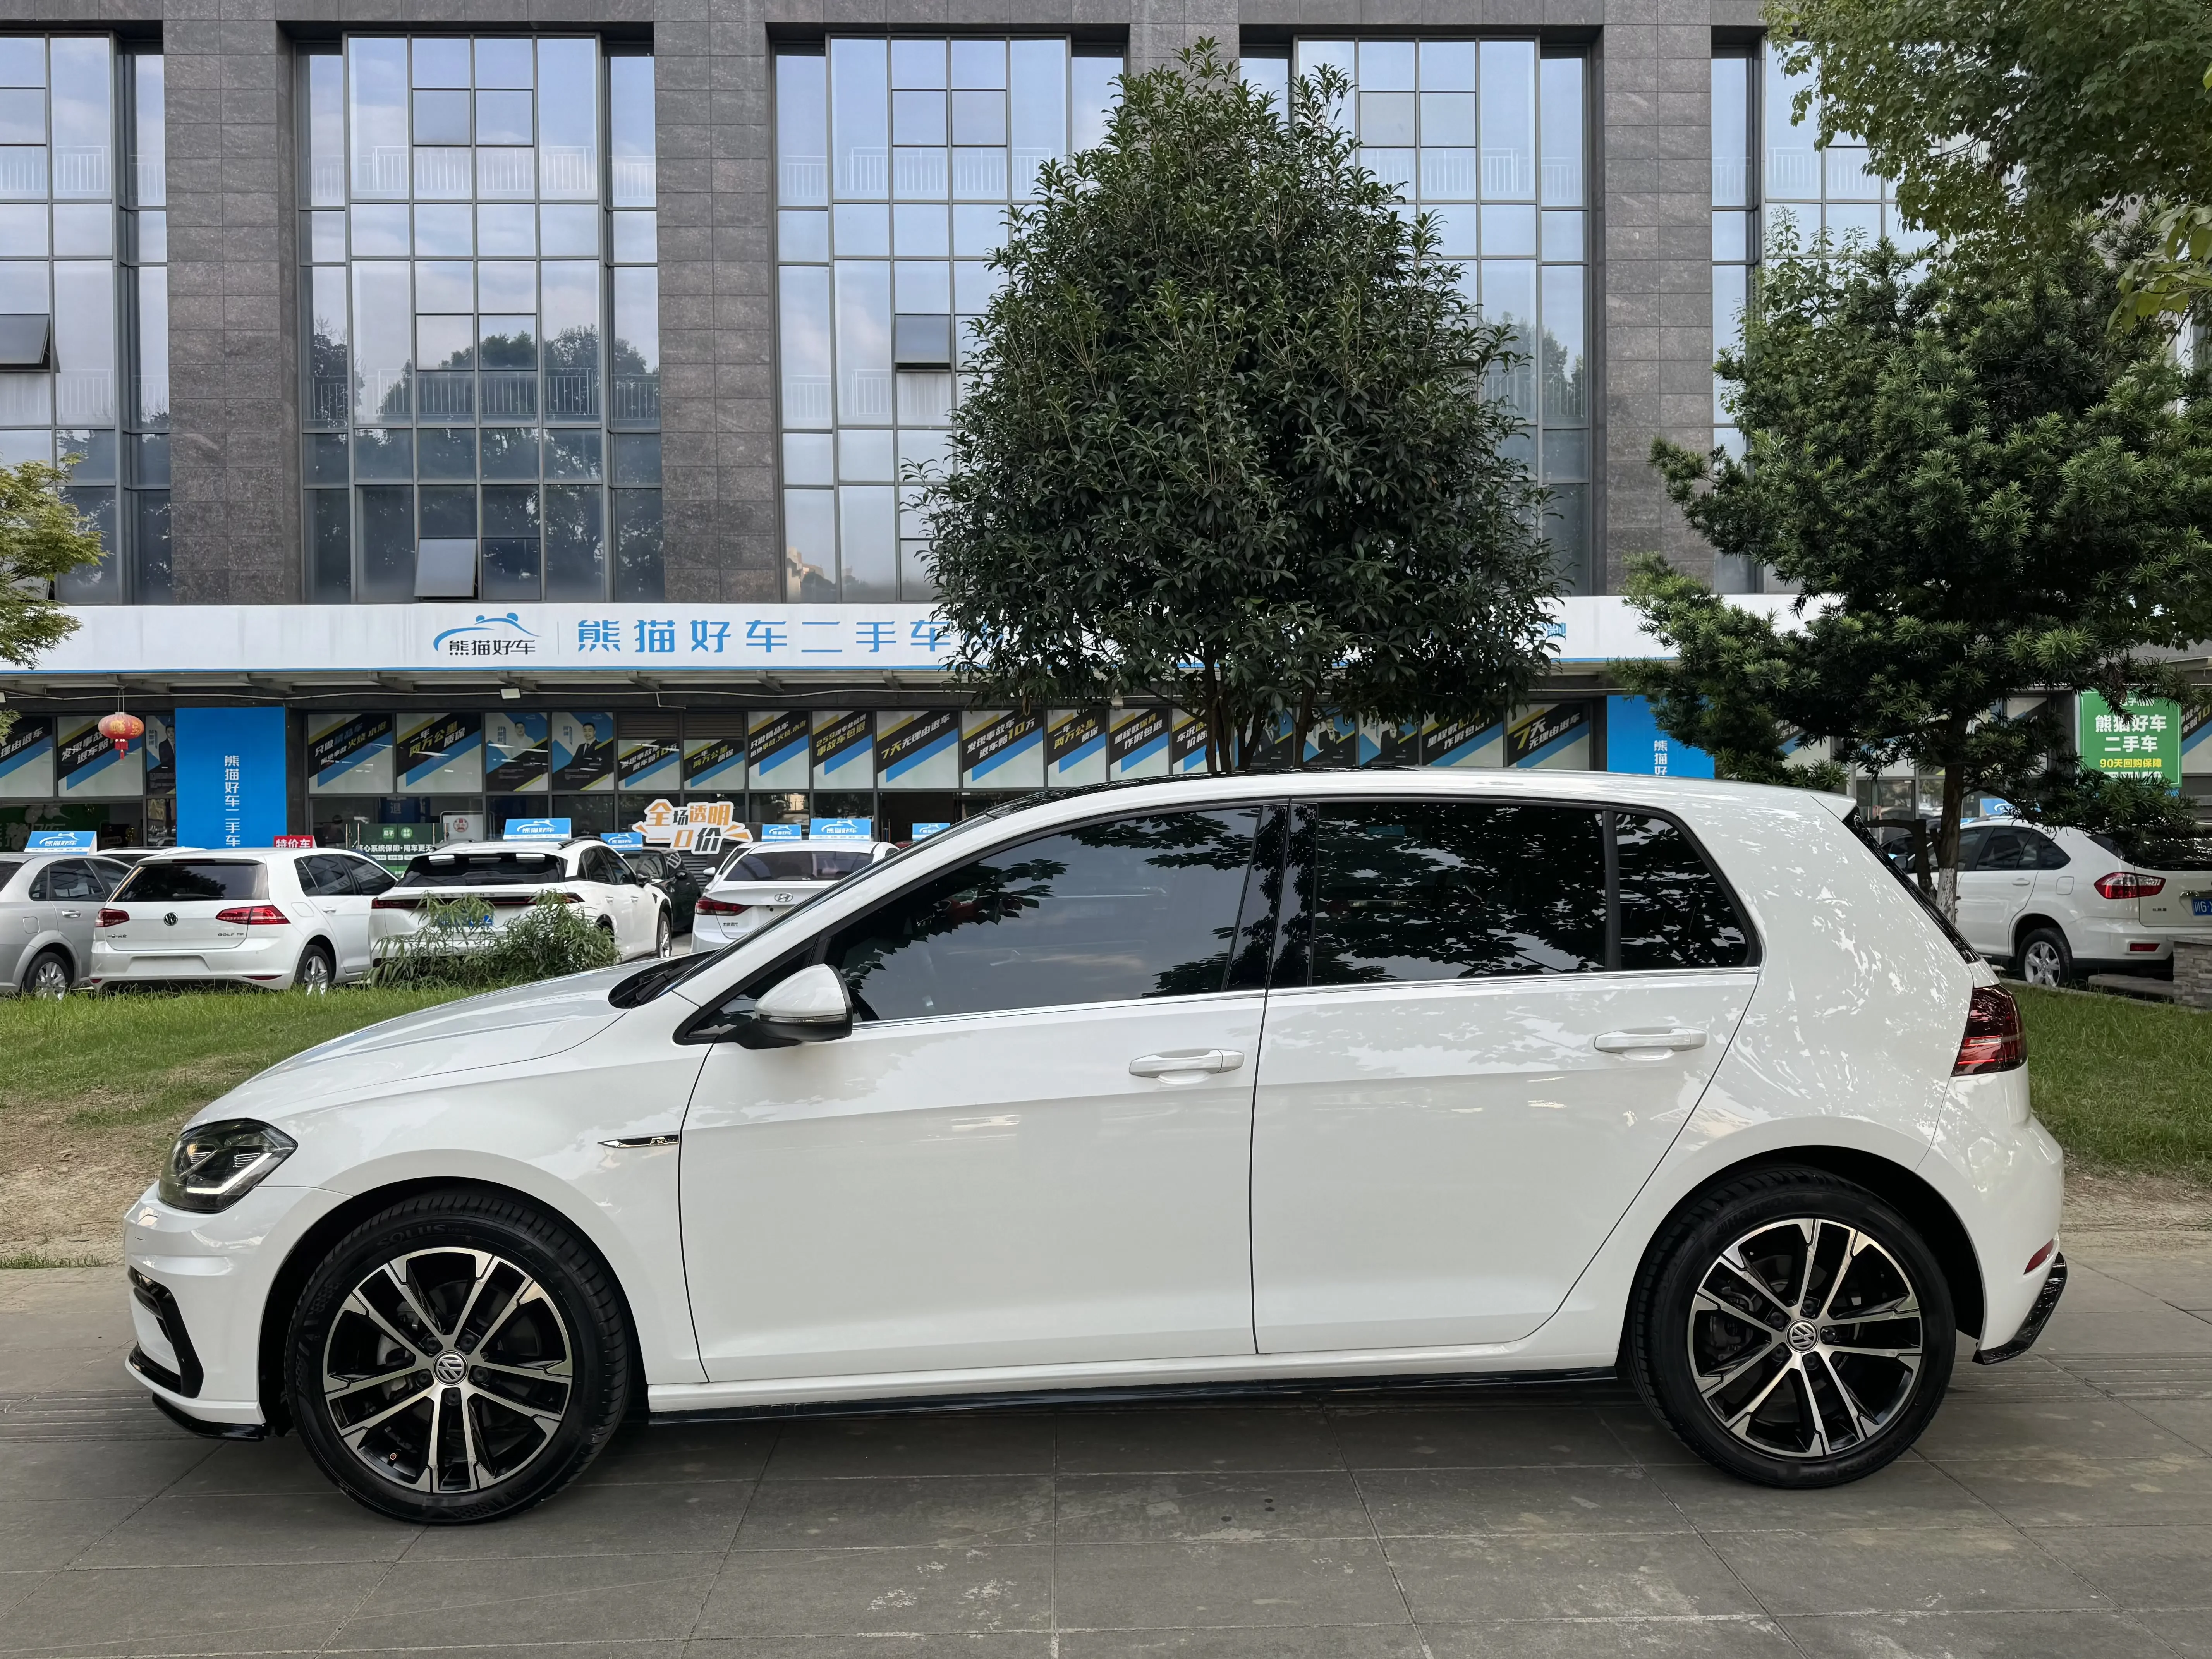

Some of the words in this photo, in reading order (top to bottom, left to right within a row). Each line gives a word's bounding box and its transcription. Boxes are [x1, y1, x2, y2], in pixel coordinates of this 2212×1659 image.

[449, 639, 536, 655] 熊猫好车
[578, 620, 1004, 652] 熊猫好车二手车
[410, 728, 430, 743] 一年
[881, 713, 950, 759] 7天无理由退车
[967, 718, 1015, 754] 发现事故车
[1054, 723, 1071, 737] 一年
[1054, 716, 1096, 750] 两万公里
[1513, 717, 1546, 750] 7天
[1528, 713, 1581, 750] 无理由退车
[2095, 714, 2167, 733] 熊猫好车
[409, 721, 457, 757] 两万公里
[979, 718, 1035, 759] 退车赔10万
[2104, 735, 2158, 752] 二手车
[2100, 758, 2162, 768] 90天回购保障
[225, 755, 240, 847] 熊猫好车二手车
[646, 802, 731, 826] 全场透明
[276, 838, 311, 848] 特价车
[649, 828, 721, 852] 一口价
